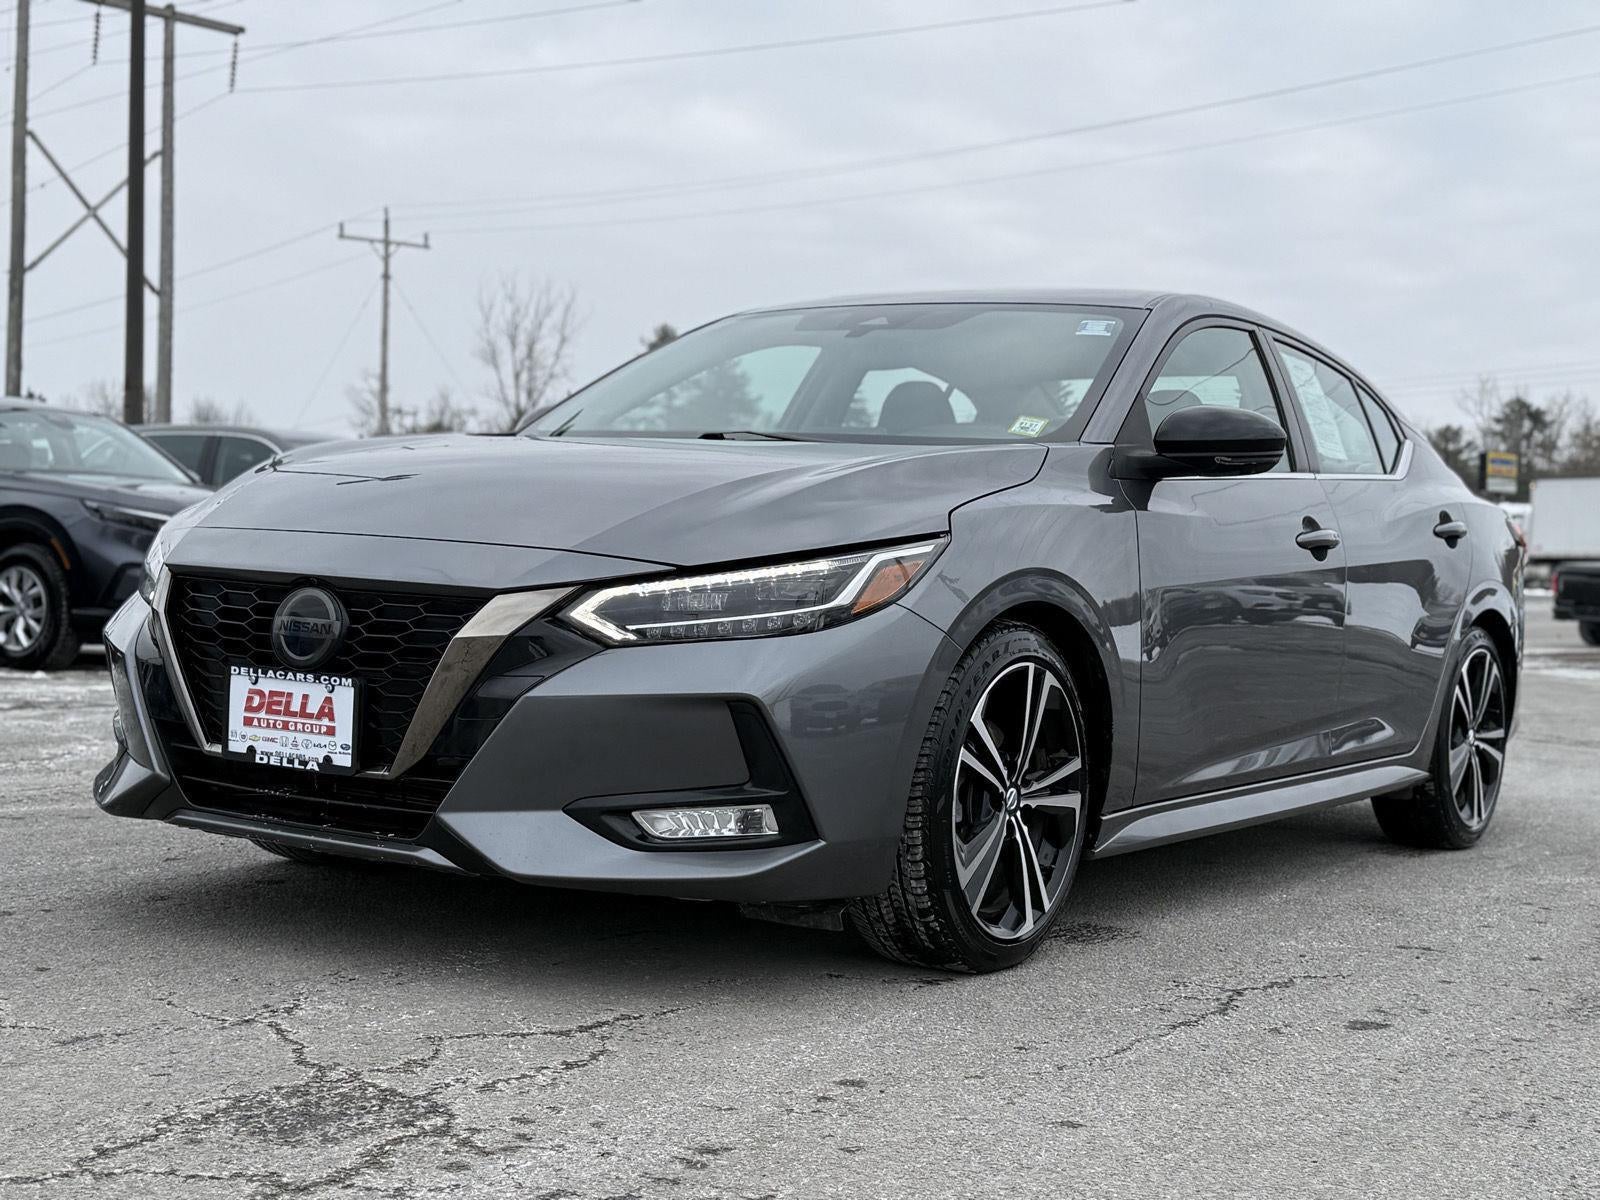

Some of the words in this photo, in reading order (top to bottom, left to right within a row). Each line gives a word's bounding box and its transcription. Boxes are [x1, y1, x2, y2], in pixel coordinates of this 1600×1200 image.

[280, 619, 333, 635] NISSAN
[230, 666, 352, 687] DELLACARS.COM
[243, 688, 336, 723] DELLA
[252, 718, 283, 729] AUTO
[288, 723, 328, 734] GROUP
[255, 755, 319, 771] DELLA
